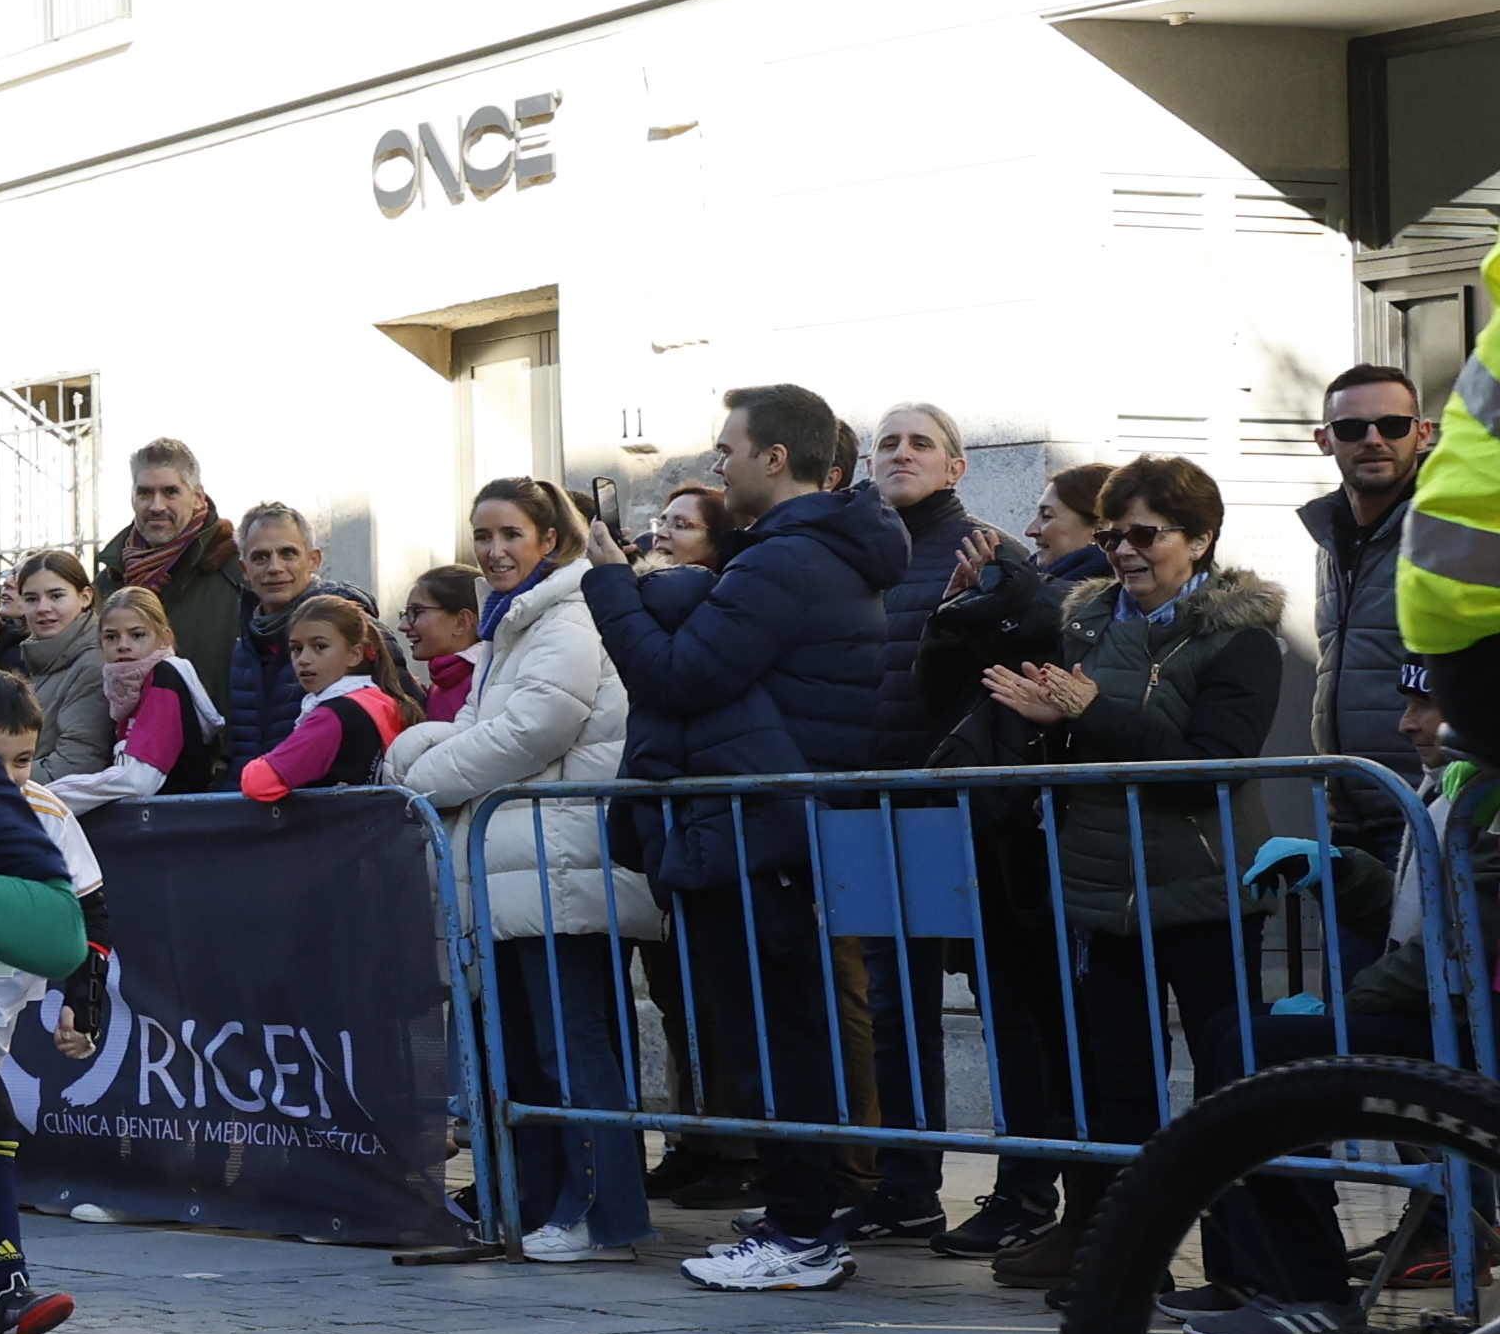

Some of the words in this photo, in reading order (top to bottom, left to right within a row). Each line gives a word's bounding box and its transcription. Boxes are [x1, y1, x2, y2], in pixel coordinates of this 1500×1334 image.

[372, 89, 563, 219] ONCE
[43, 1108, 111, 1137] CLÍNICA
[116, 1116, 183, 1140] DENTAL
[186, 1119, 201, 1143] Y
[204, 1120, 301, 1147] MEDICINA
[304, 1126, 387, 1155] ESTÉTICA
